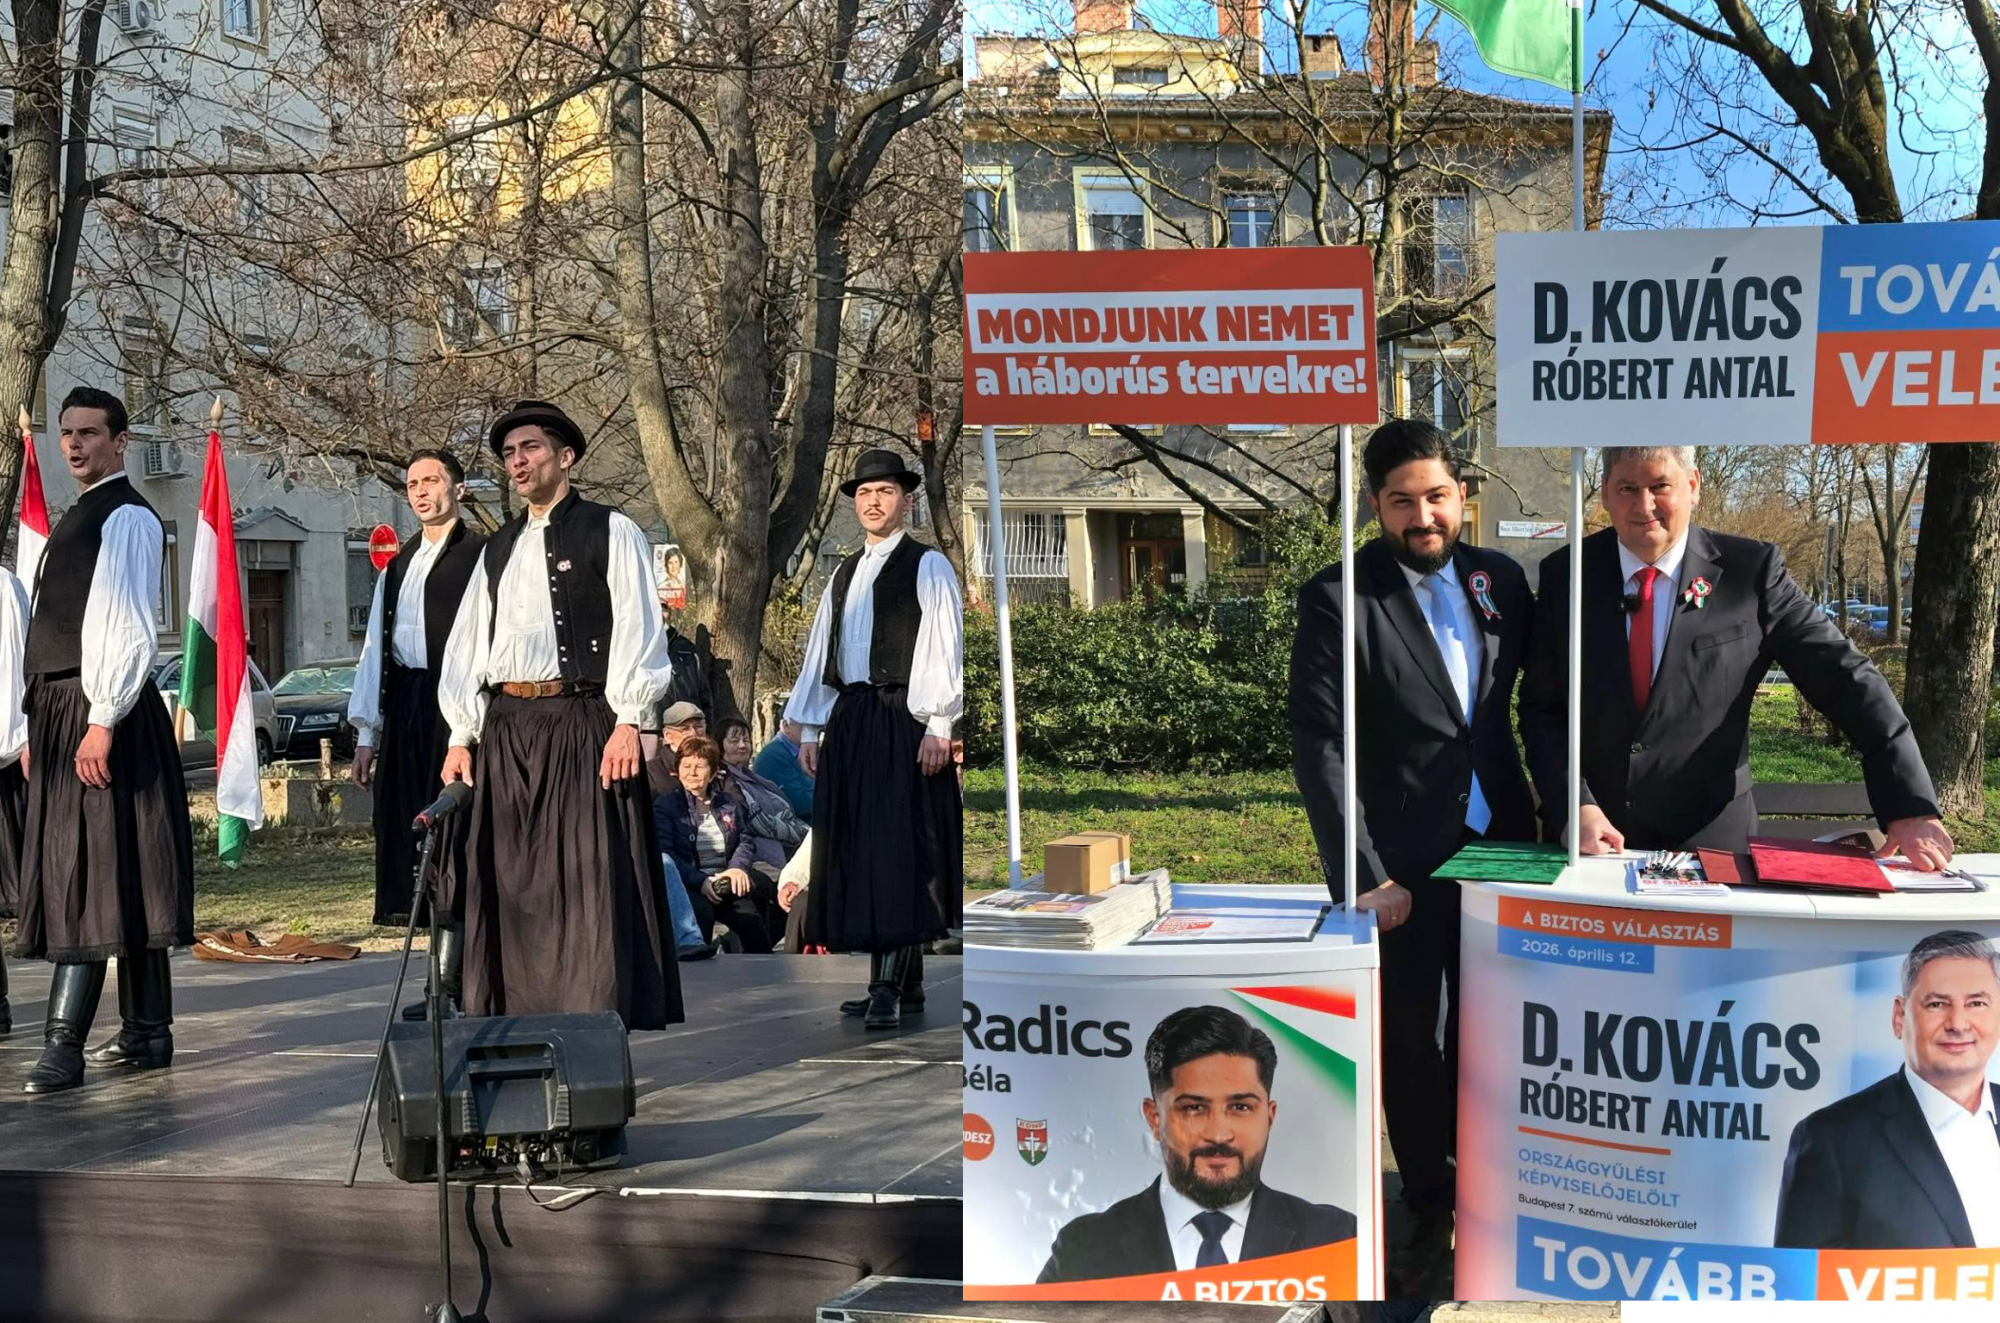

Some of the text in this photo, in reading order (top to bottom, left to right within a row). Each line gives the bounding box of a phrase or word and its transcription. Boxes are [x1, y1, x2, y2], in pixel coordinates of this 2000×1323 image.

[1533, 257, 1802, 344] D. KOVÁCS
[977, 304, 1354, 344] MONDJUNK NEMET
[975, 355, 1367, 395] a háborús tervekre!
[1533, 346, 1795, 401] RÓBERT ANTAL
[1521, 911, 1720, 942] A BIZTOS VÁLASZTÁS
[1521, 939, 1640, 966] 2026. április 12.
[963, 1000, 1133, 1058] Radics
[1523, 1001, 1821, 1091] D. KOVÁCS
[1519, 1073, 1770, 1141] RÓBERT ANTAL
[1518, 1148, 1666, 1186] ORSZÁGGYŰLÉSI
[1518, 1169, 1681, 1209] KÉPVISELŐJELÖLT
[1518, 1193, 1697, 1231] Budapest 7. számú választókerület
[1160, 1276, 1327, 1301] A BIZTOS
[1533, 1236, 1795, 1301] TOVÁBB
[1837, 1265, 2000, 1301] VELE
